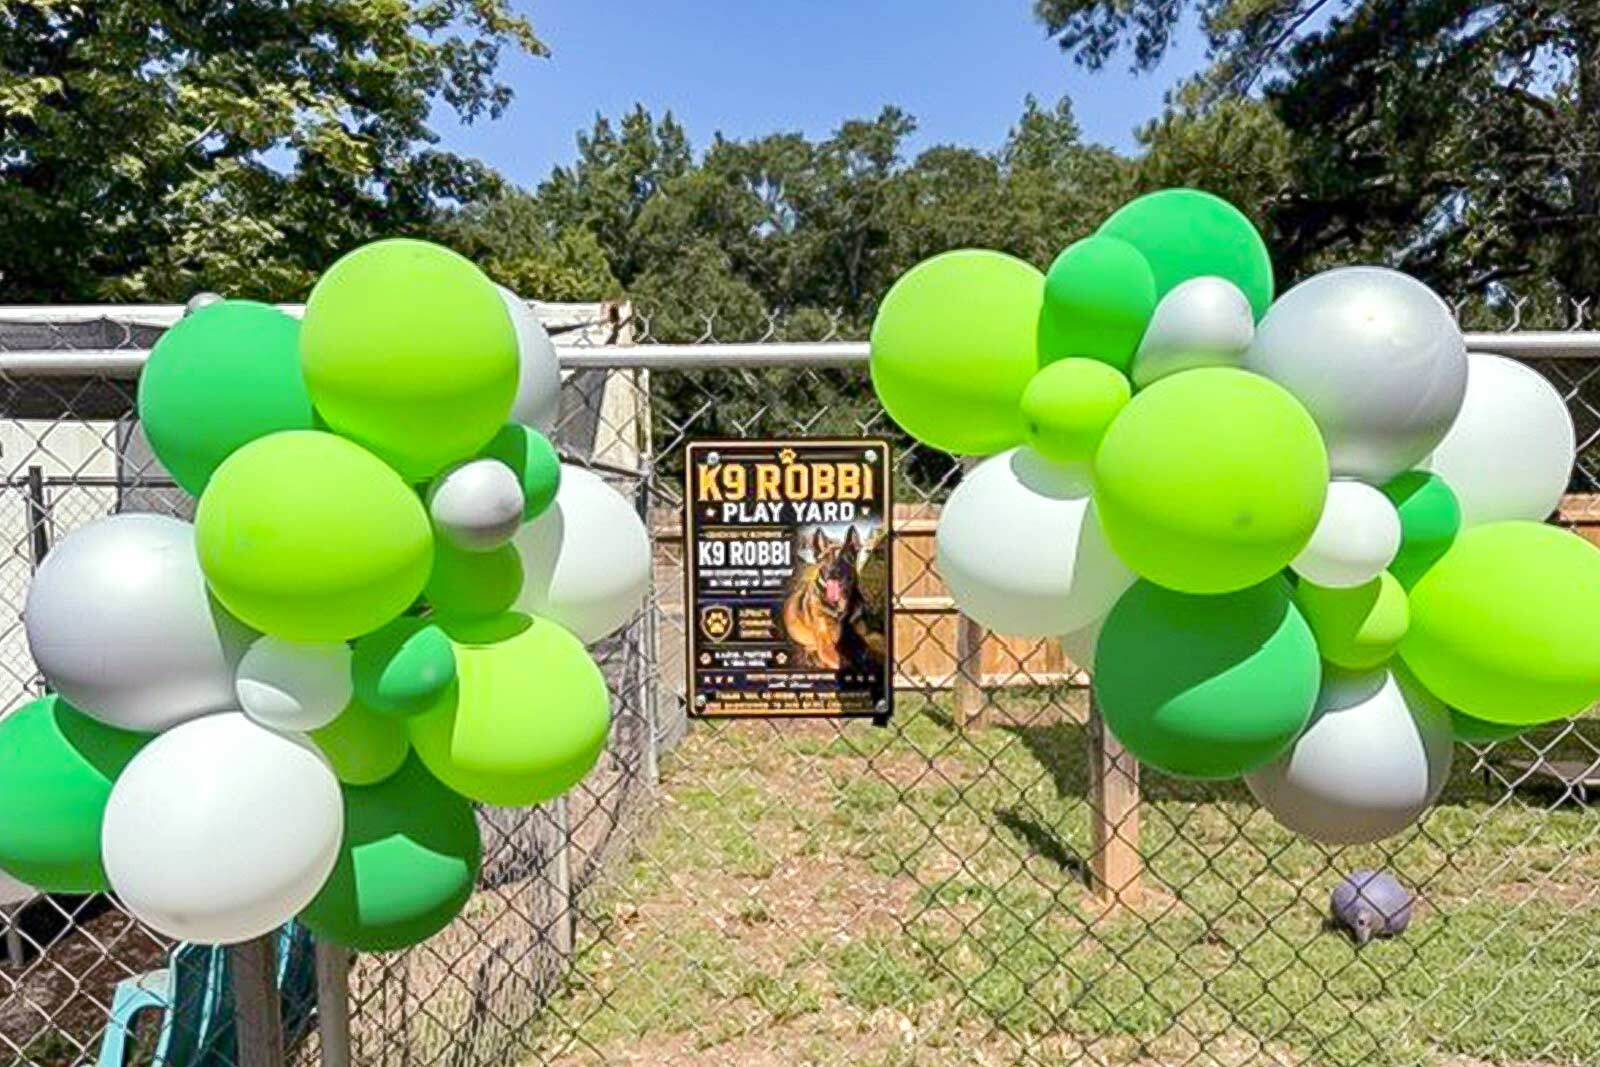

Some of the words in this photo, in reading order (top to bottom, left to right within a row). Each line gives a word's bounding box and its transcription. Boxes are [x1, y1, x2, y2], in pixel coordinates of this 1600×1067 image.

[698, 463, 747, 501] K9
[756, 463, 874, 501] ROBBI
[722, 502, 785, 523] PLAY
[791, 502, 855, 523] YARD
[698, 540, 725, 566] K9
[729, 540, 791, 566] ROBBI
